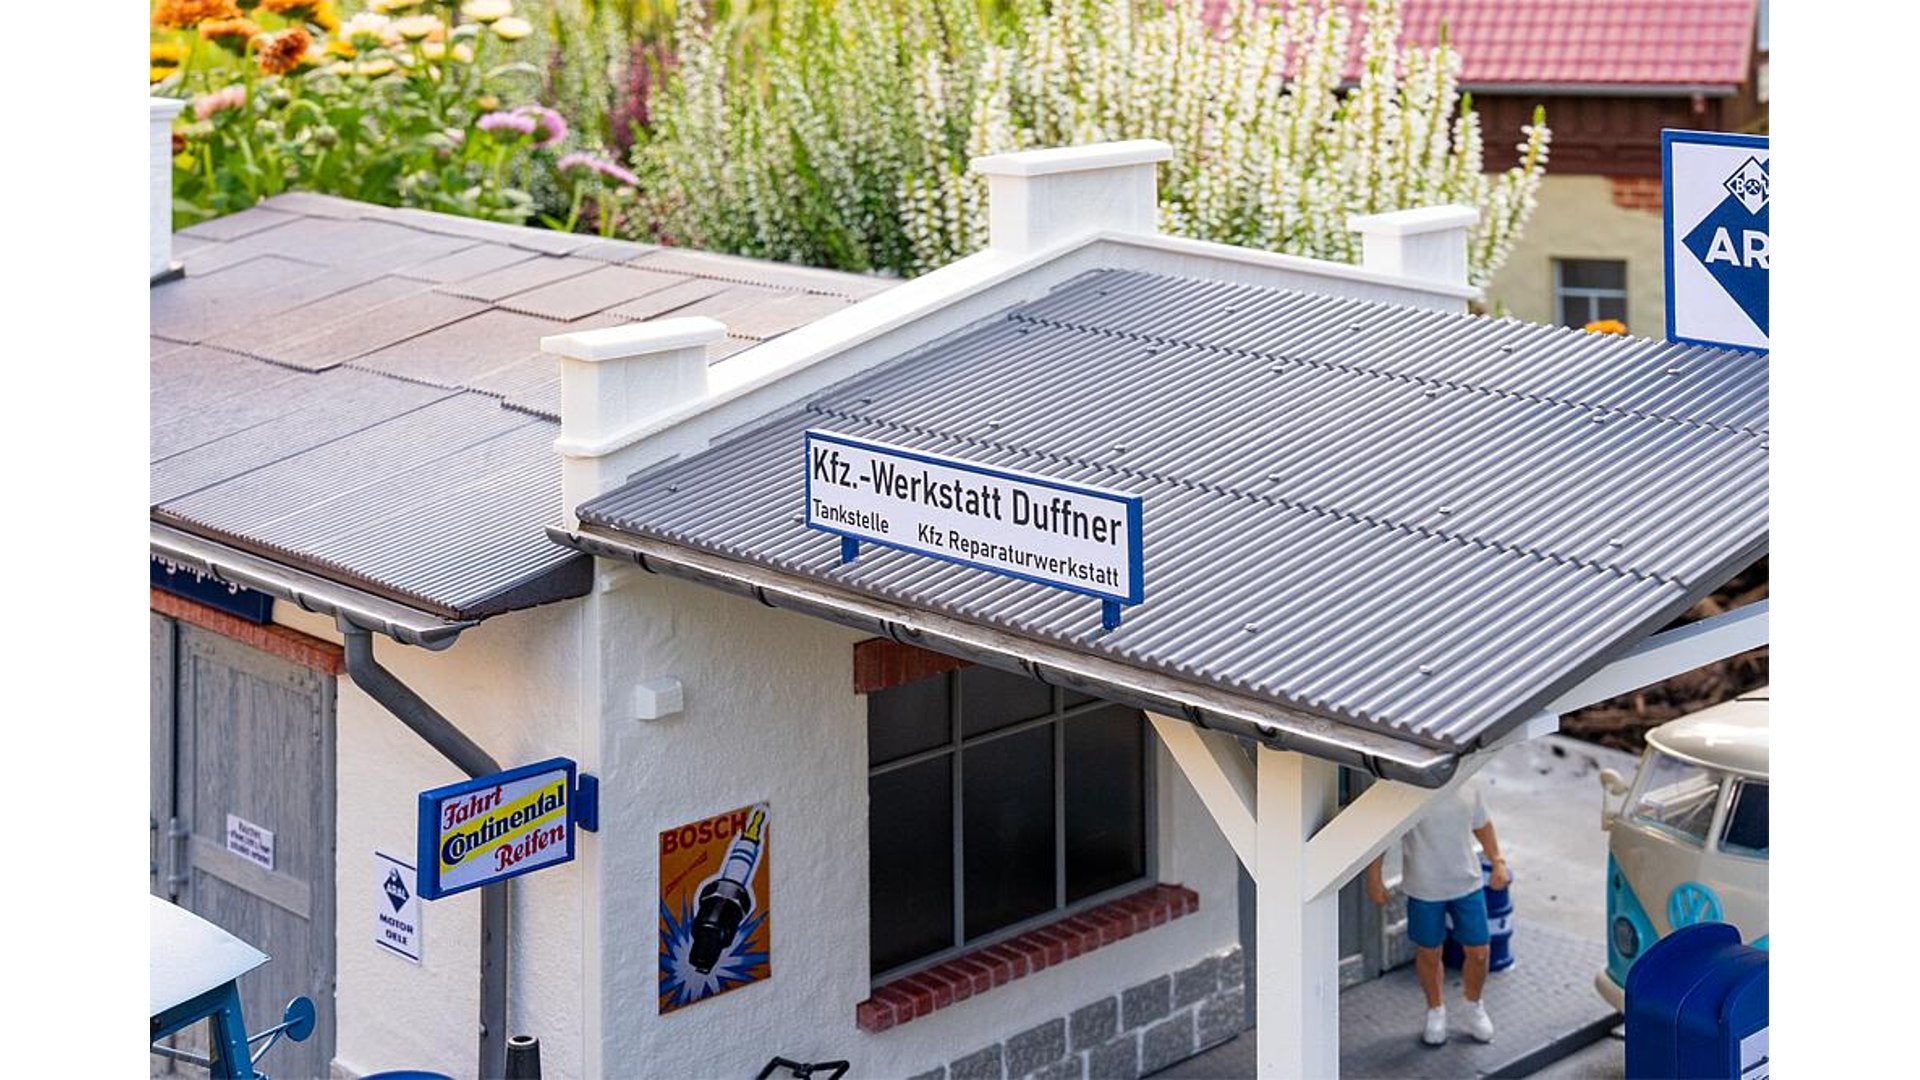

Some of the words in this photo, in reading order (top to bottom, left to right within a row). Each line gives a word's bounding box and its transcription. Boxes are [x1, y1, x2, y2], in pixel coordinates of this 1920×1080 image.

[813, 446, 1003, 521] Kfz.-Werkstatt
[1012, 489, 1122, 546] Duffner
[813, 498, 889, 534] Tankstelle
[918, 522, 943, 546] Kfz
[949, 530, 1119, 587] Reparaturwerkstatt
[441, 784, 565, 866] Continental
[443, 785, 503, 830] Fahrt
[494, 824, 565, 872] Reifen
[662, 811, 749, 856] BOSCH
[379, 913, 414, 934] MOTOR
